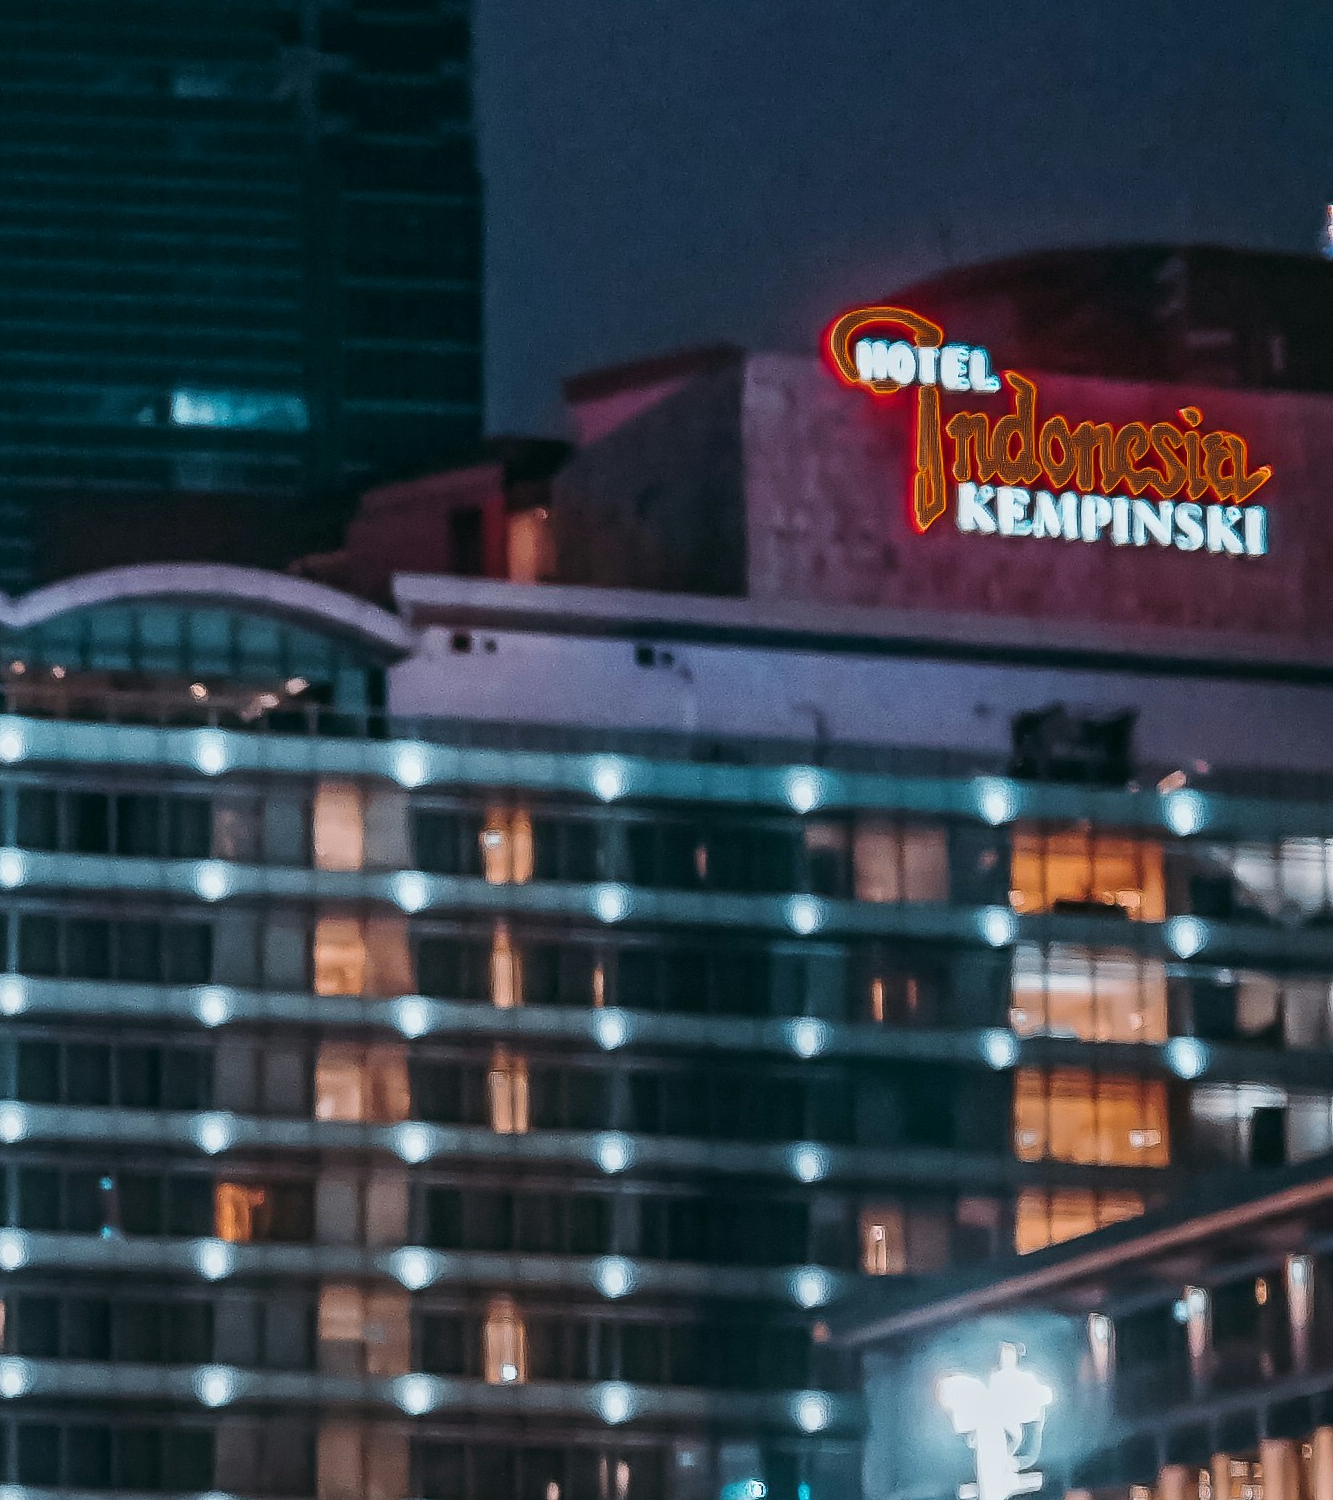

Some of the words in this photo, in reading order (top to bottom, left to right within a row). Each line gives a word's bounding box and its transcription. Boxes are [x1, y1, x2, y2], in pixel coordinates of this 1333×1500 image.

[854, 337, 1001, 393] HOTEL
[830, 306, 1272, 532] Indonesia
[955, 481, 1269, 555] KEMPINSKI
